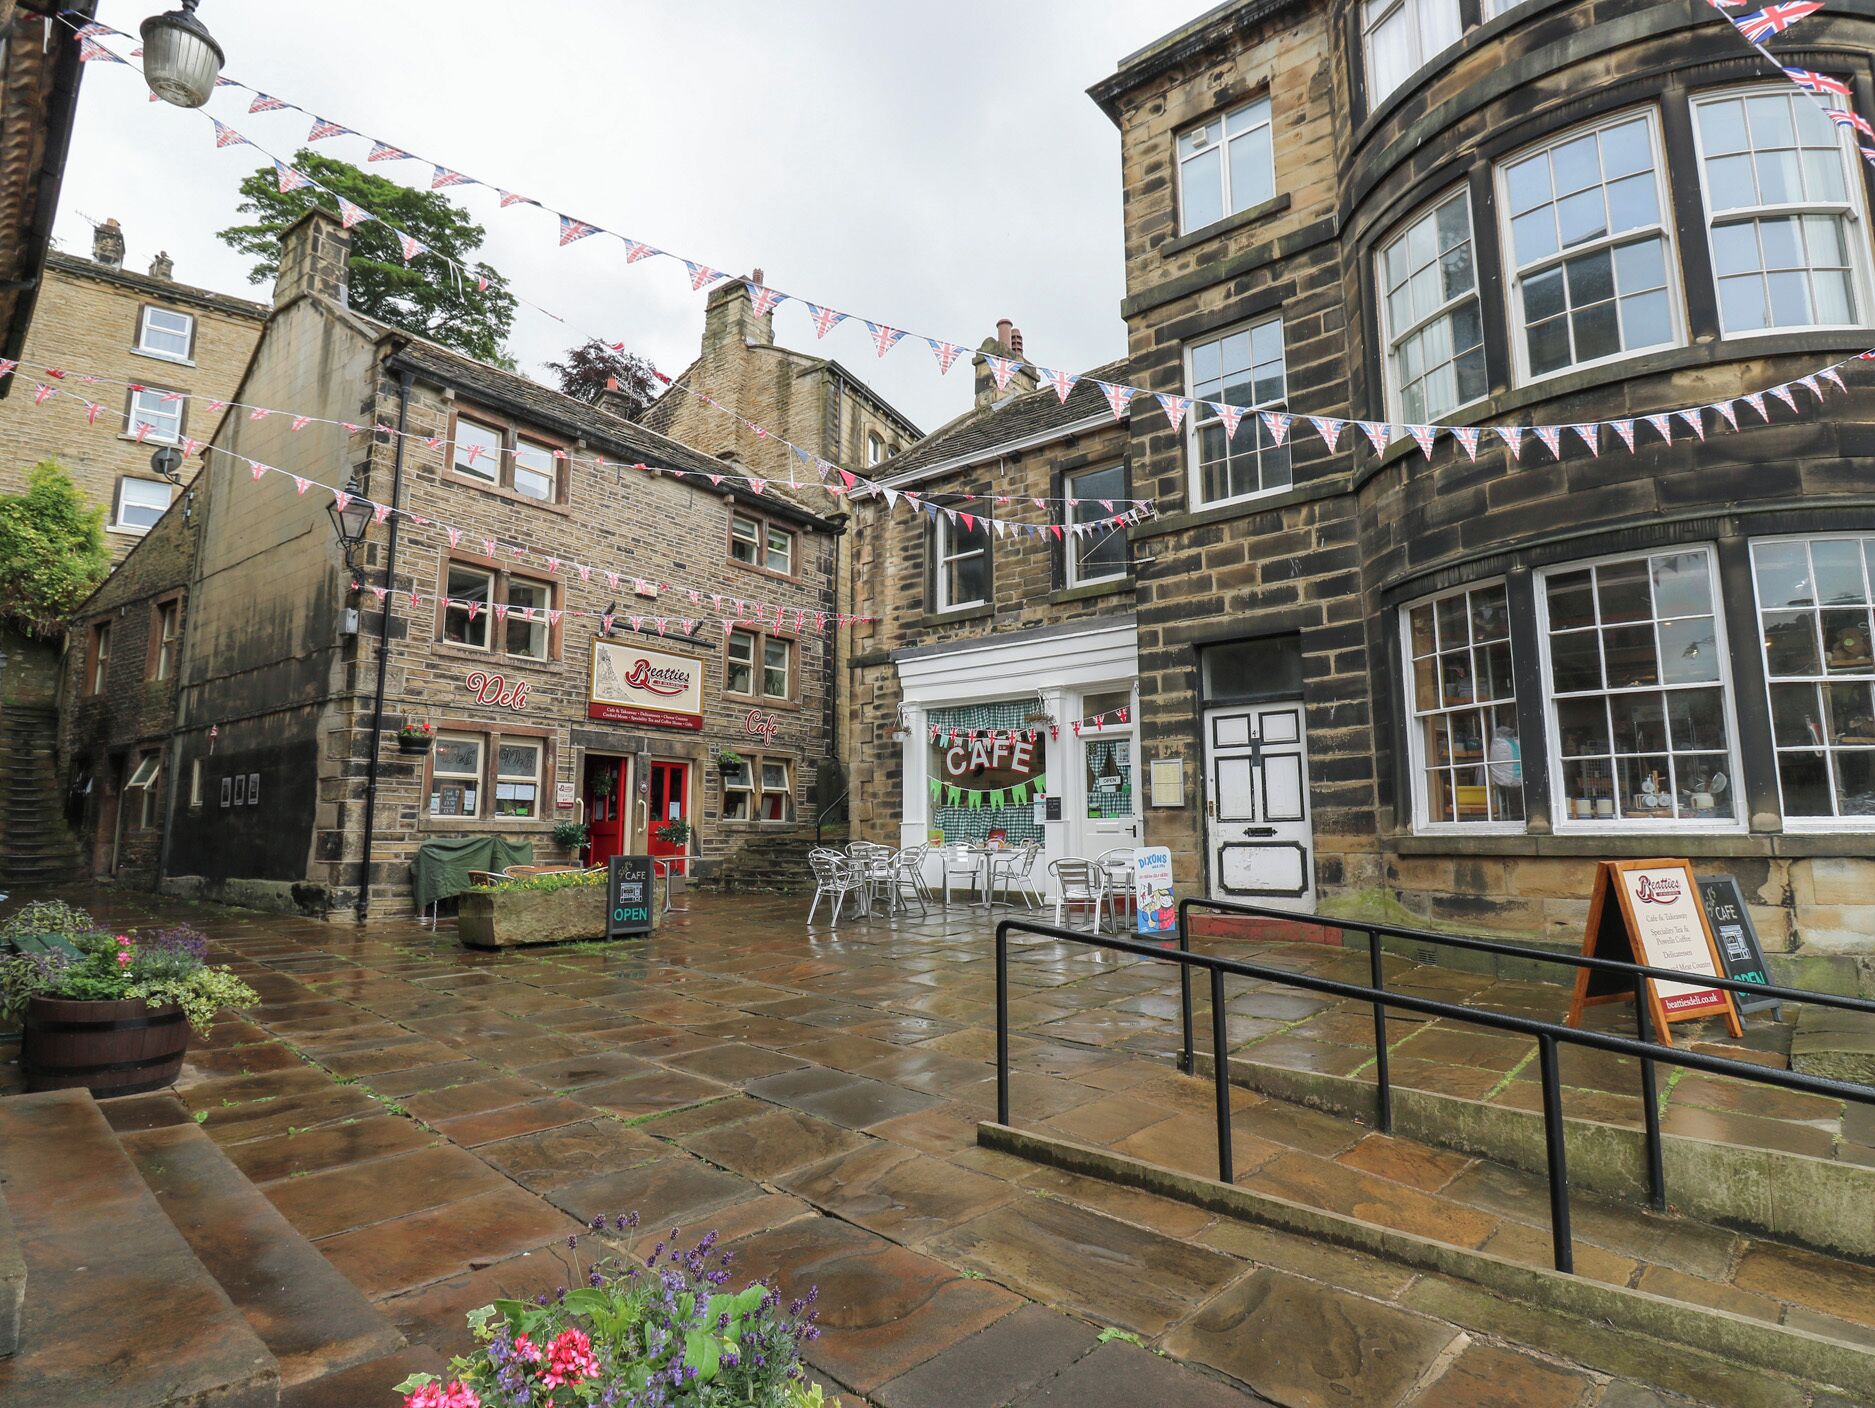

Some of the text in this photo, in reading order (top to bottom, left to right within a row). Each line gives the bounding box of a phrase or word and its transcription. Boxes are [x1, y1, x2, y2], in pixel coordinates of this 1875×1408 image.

[625, 659, 690, 696] Beatties
[466, 671, 531, 710] Deli
[746, 709, 777, 746] Cafe
[946, 740, 1033, 776] CAFE
[1138, 854, 1168, 869] DIXONS
[625, 871, 646, 880] CAFE
[1636, 875, 1680, 904] Beatties
[614, 907, 648, 921] OPEN
[1646, 914, 1658, 922] Cafe
[1664, 913, 1687, 921] Takeaway
[1715, 904, 1738, 921] CAFE
[1665, 993, 1719, 1009] beattiesdeli.co.uk
